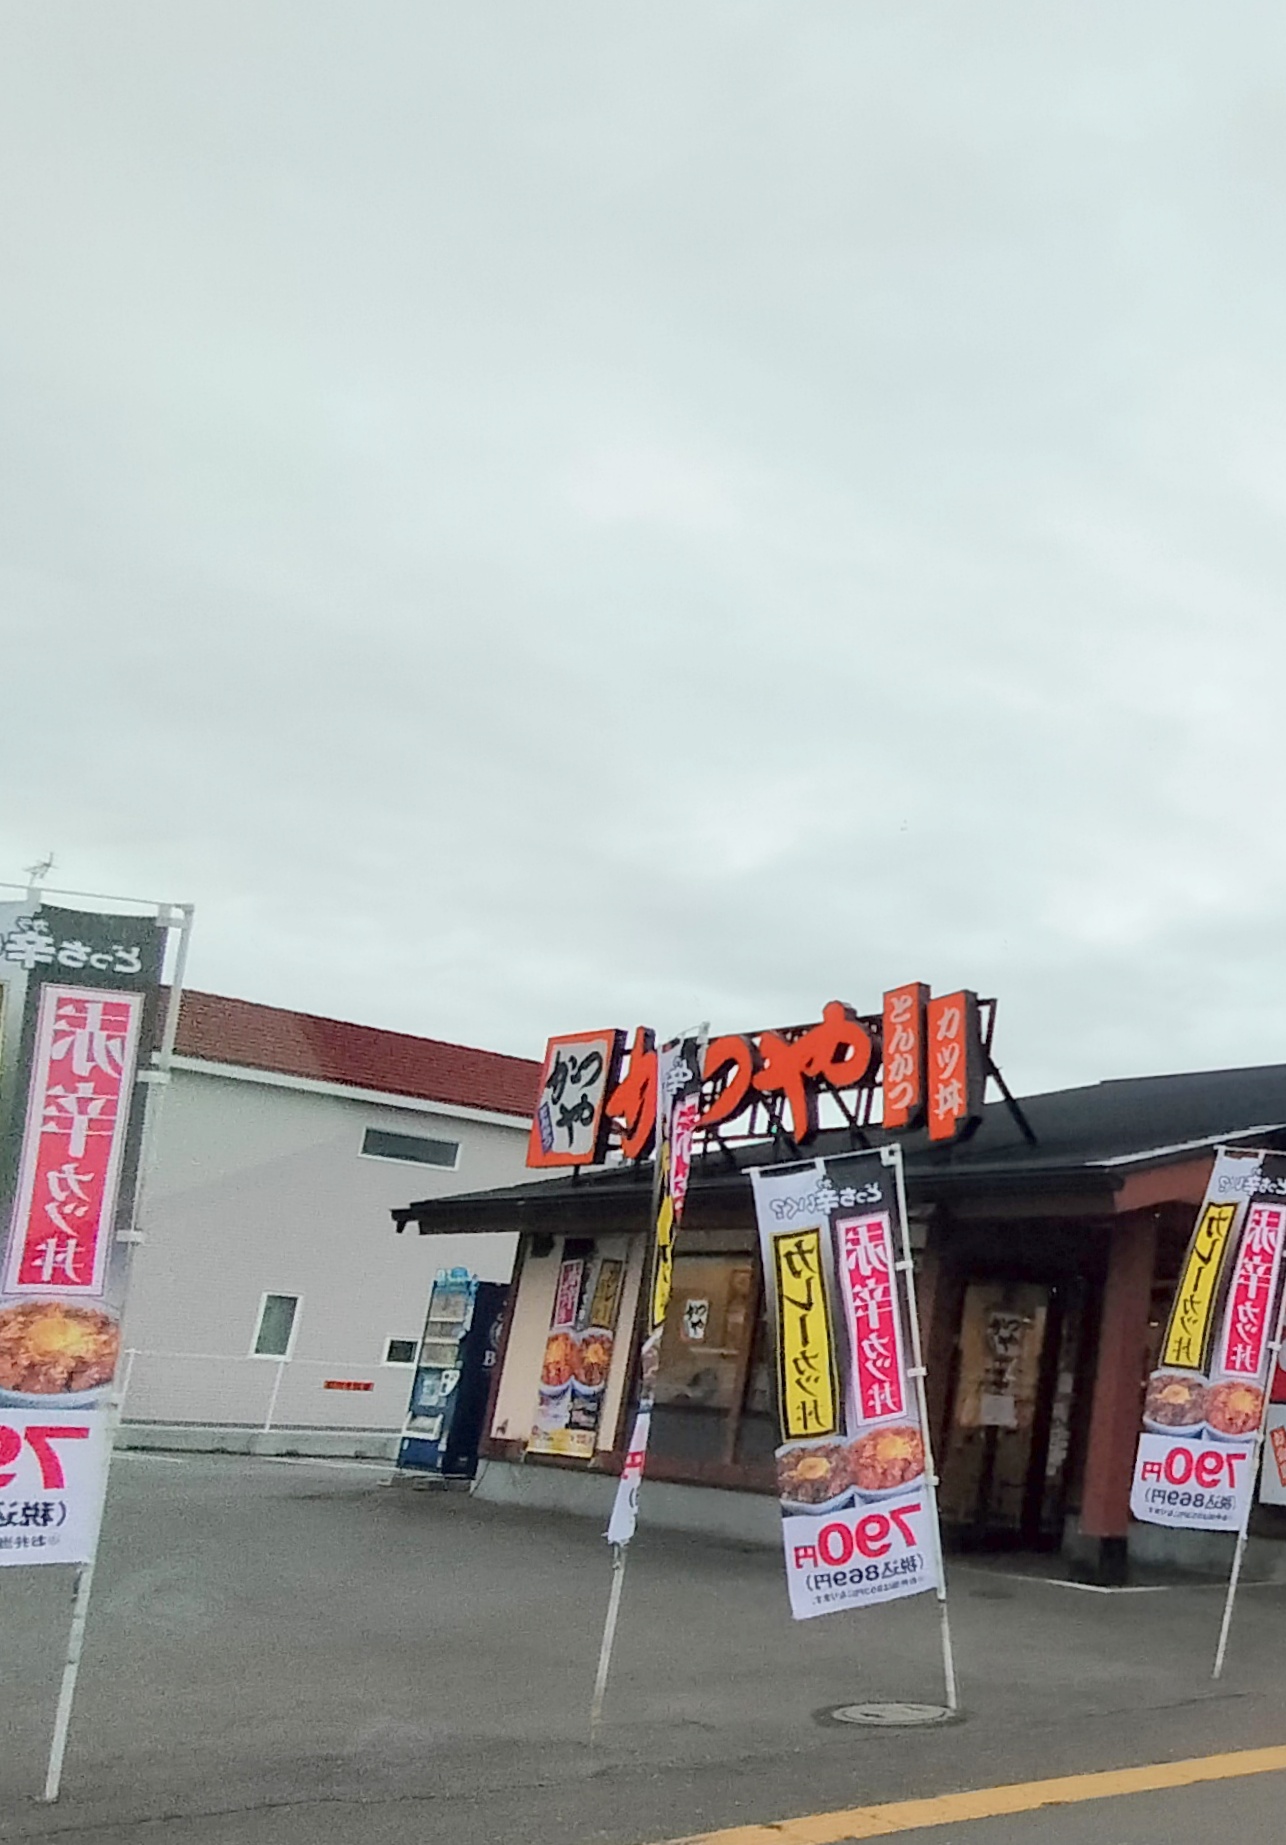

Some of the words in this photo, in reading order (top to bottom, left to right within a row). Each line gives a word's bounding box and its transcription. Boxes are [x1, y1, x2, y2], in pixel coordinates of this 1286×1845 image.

[546, 1050, 603, 1105] かつ
[888, 994, 915, 1110] とんかつ
[934, 1006, 963, 1121] カツ丼
[556, 1092, 595, 1148] や
